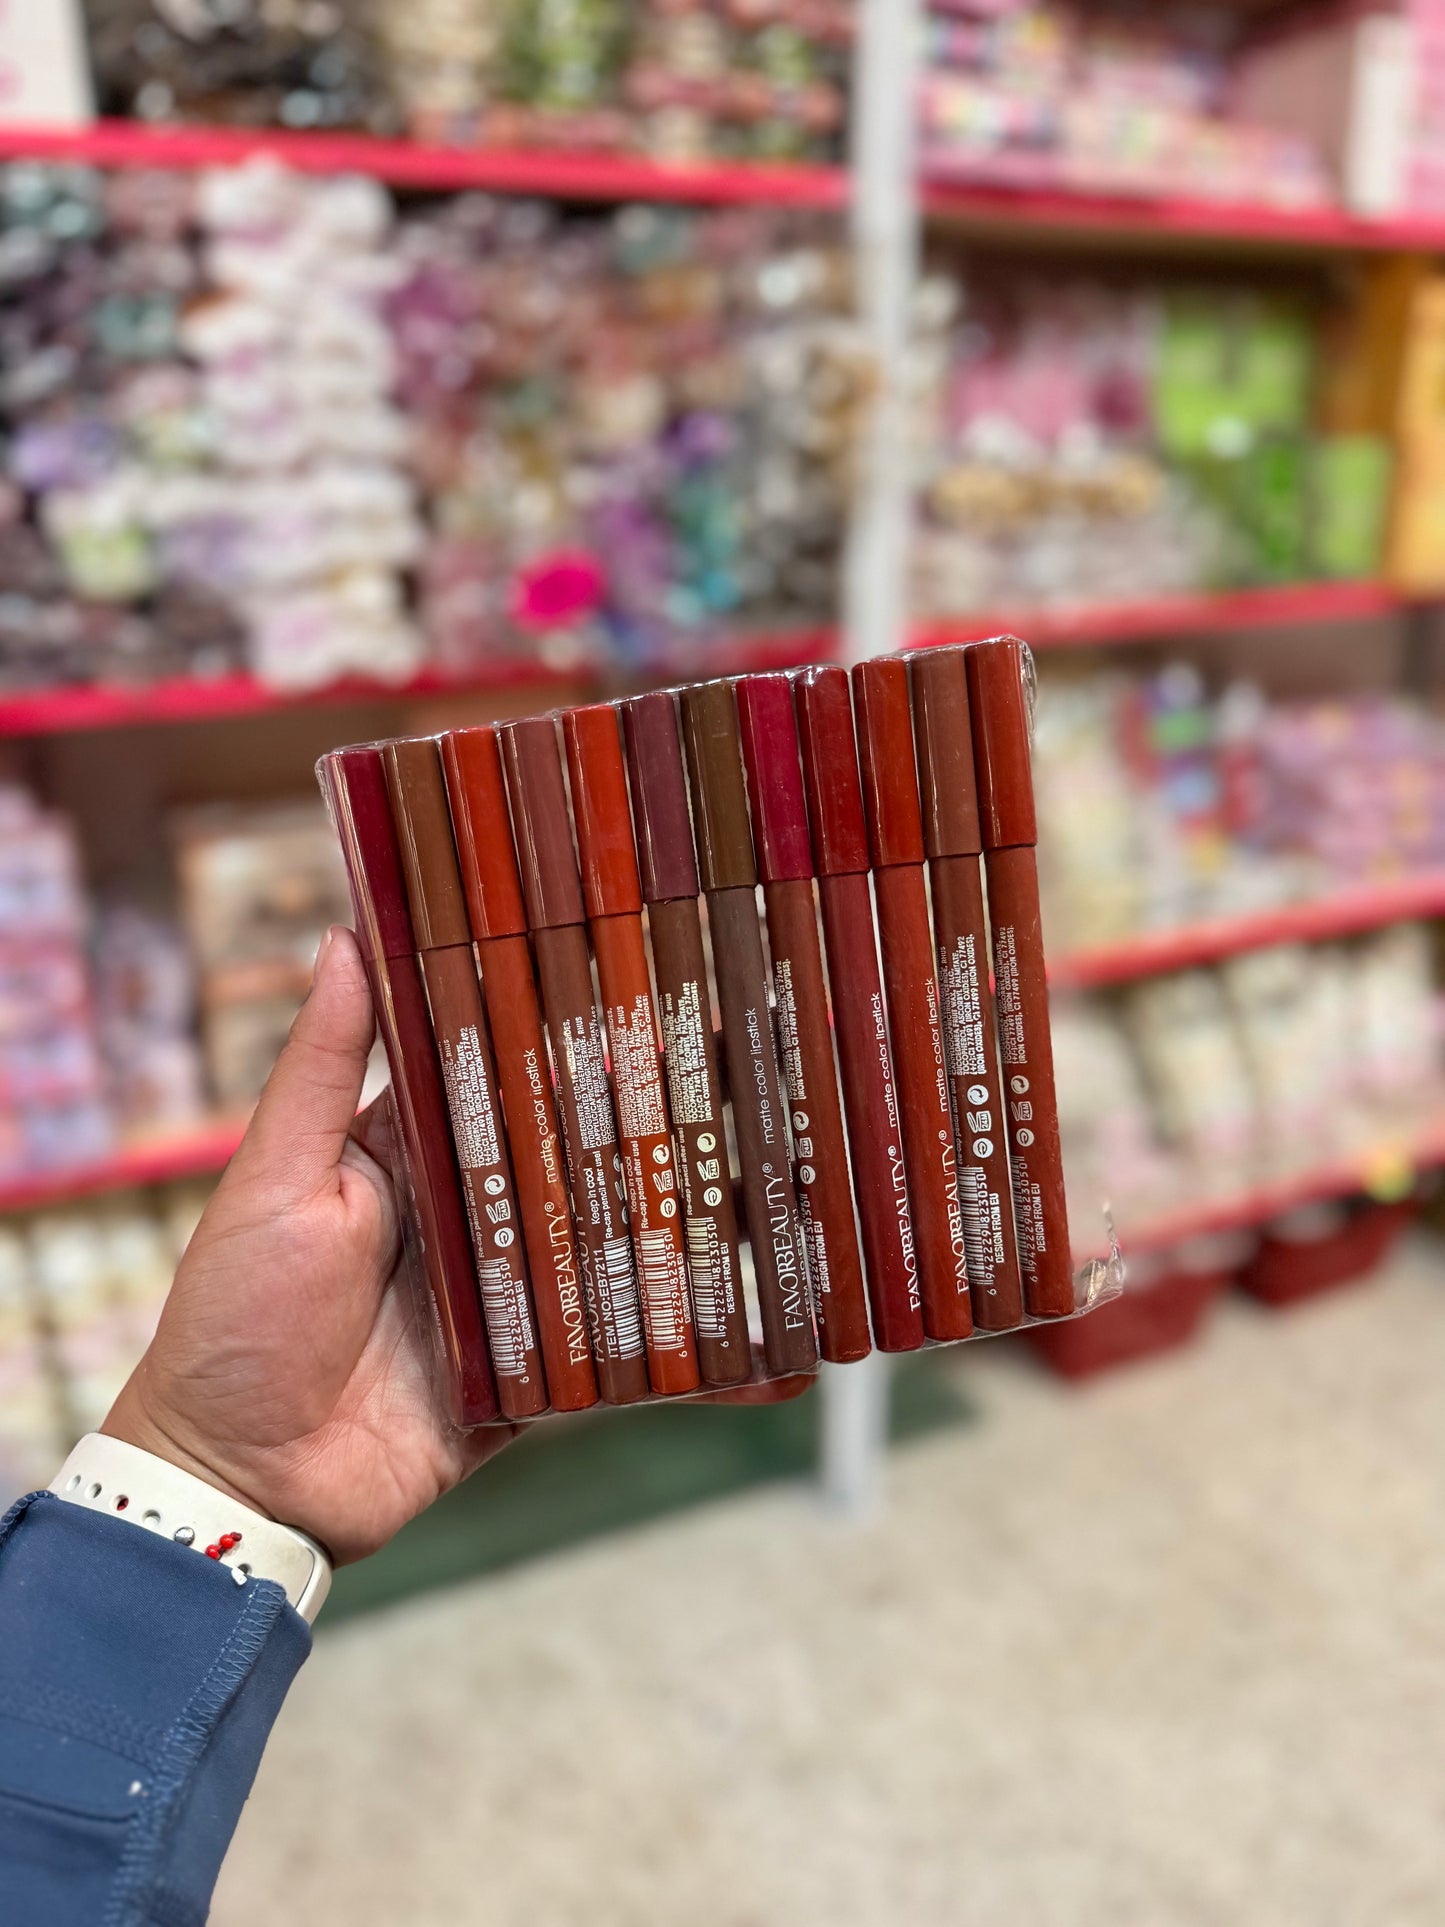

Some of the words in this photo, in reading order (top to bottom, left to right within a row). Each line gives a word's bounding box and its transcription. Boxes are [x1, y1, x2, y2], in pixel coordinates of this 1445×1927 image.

[924, 977, 939, 1024] lipstick
[1011, 978, 1019, 1000] 77499
[744, 1007, 763, 1054] lipstick
[870, 991, 886, 1039] lipstick
[877, 1041, 890, 1079] color
[930, 1027, 942, 1064] color
[752, 1058, 768, 1095] color
[935, 1067, 948, 1112] matte
[531, 1097, 548, 1136] color
[882, 1082, 896, 1127] matte
[757, 1098, 775, 1144] matte
[538, 1138, 557, 1183] matte
[595, 1167, 605, 1185] after
[624, 1155, 633, 1176] cool
[633, 1157, 642, 1175] after
[583, 1167, 595, 1188] cool
[587, 1189, 596, 1198] in
[627, 1178, 634, 1186] in
[635, 1177, 646, 1200] pencil
[1018, 1162, 1031, 1211] 823050
[1031, 1182, 1040, 1194] EU
[588, 1199, 601, 1224] Keep
[598, 1186, 610, 1209] pencil
[628, 1187, 638, 1212] Keep
[976, 1173, 990, 1223] 823050
[989, 1192, 998, 1205] EU
[1032, 1195, 1043, 1219] FROM
[602, 1211, 613, 1238] Re-cap
[638, 1201, 650, 1228] Re-cap
[813, 1220, 822, 1233] EU
[990, 1205, 1001, 1230] FROM
[707, 1223, 721, 1273] 823050
[719, 1241, 728, 1254] EU
[815, 1234, 826, 1258] FROM
[993, 1231, 1004, 1263] DESIGN
[1024, 1217, 1036, 1265] 942229
[1035, 1221, 1046, 1251] DESIGN
[664, 1233, 678, 1284] 823050
[676, 1251, 683, 1264] EU
[721, 1255, 731, 1279] FROM
[981, 1229, 995, 1279] 942229
[500, 1262, 517, 1311] 823050
[513, 1279, 524, 1292] EU
[593, 1248, 613, 1321] NO:EB7211
[678, 1265, 687, 1289] FROM
[819, 1260, 831, 1292] DESIGN
[516, 1293, 529, 1317] FROM
[681, 1290, 691, 1323] DESIGN
[713, 1280, 727, 1330] 942229
[725, 1281, 736, 1312] DESIGN
[643, 1312, 652, 1346] ITEM
[672, 1291, 685, 1341] 942229
[509, 1319, 526, 1368] 942229
[520, 1317, 534, 1349] DESIGN
[605, 1324, 618, 1358] ITEM
